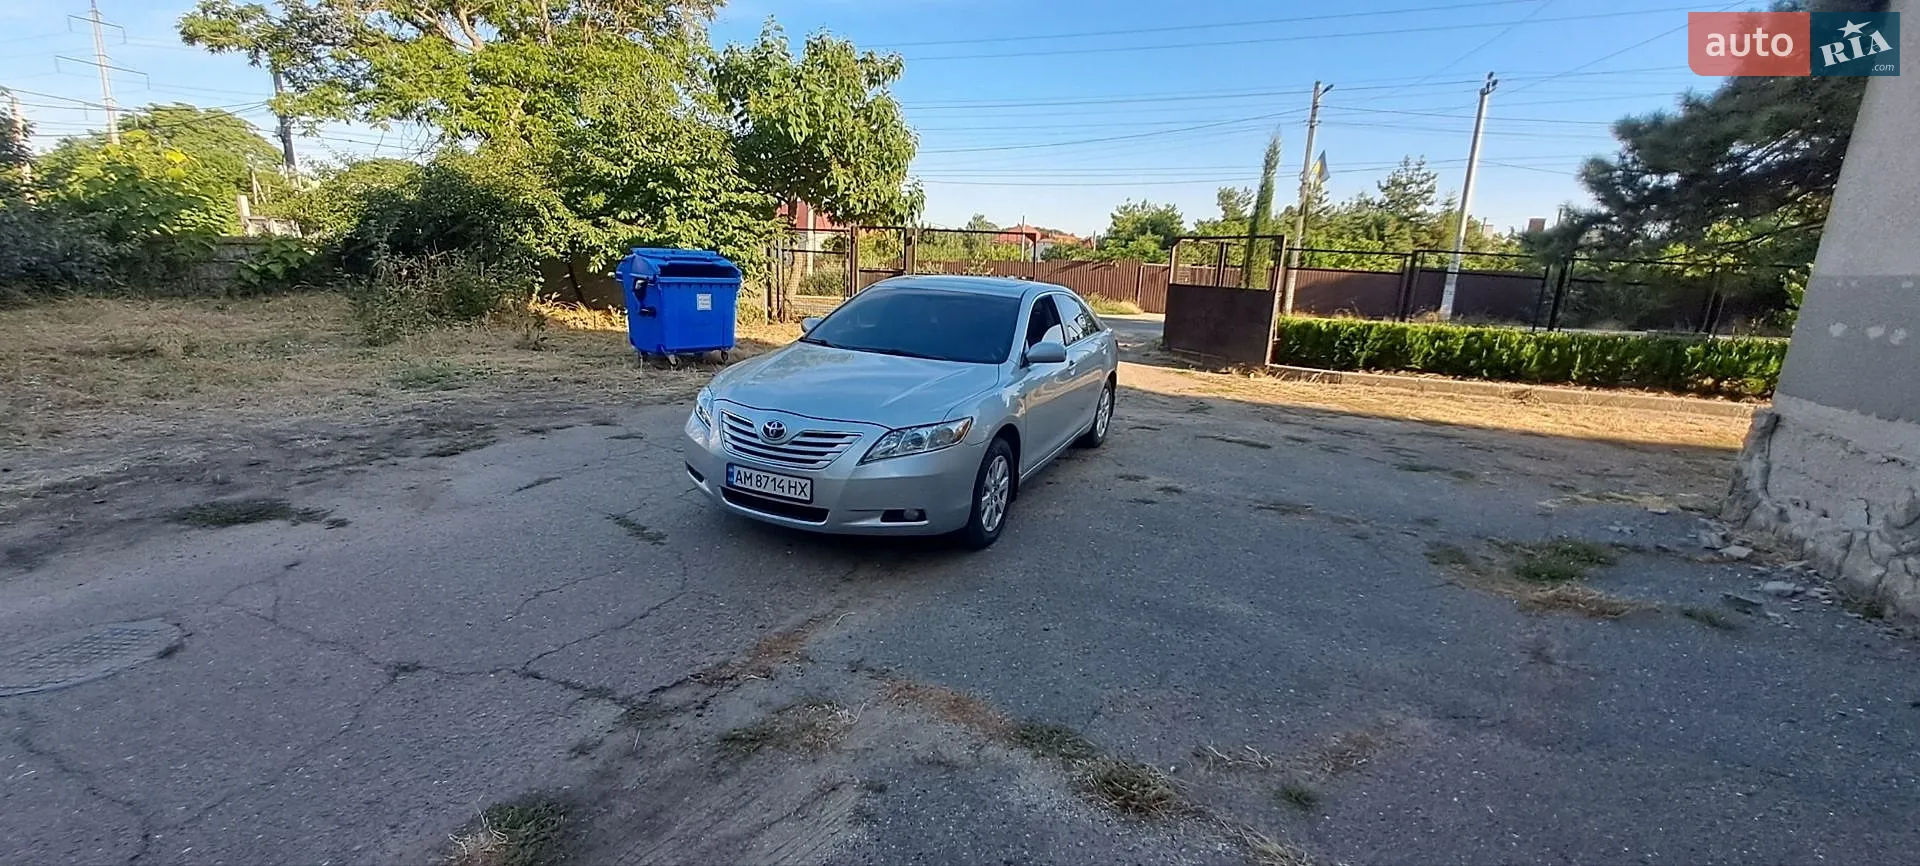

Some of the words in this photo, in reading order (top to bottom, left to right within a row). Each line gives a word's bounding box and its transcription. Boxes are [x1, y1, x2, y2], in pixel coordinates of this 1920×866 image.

[735, 470, 753, 486] AM
[755, 474, 785, 493] 8714
[788, 480, 808, 497] HX
